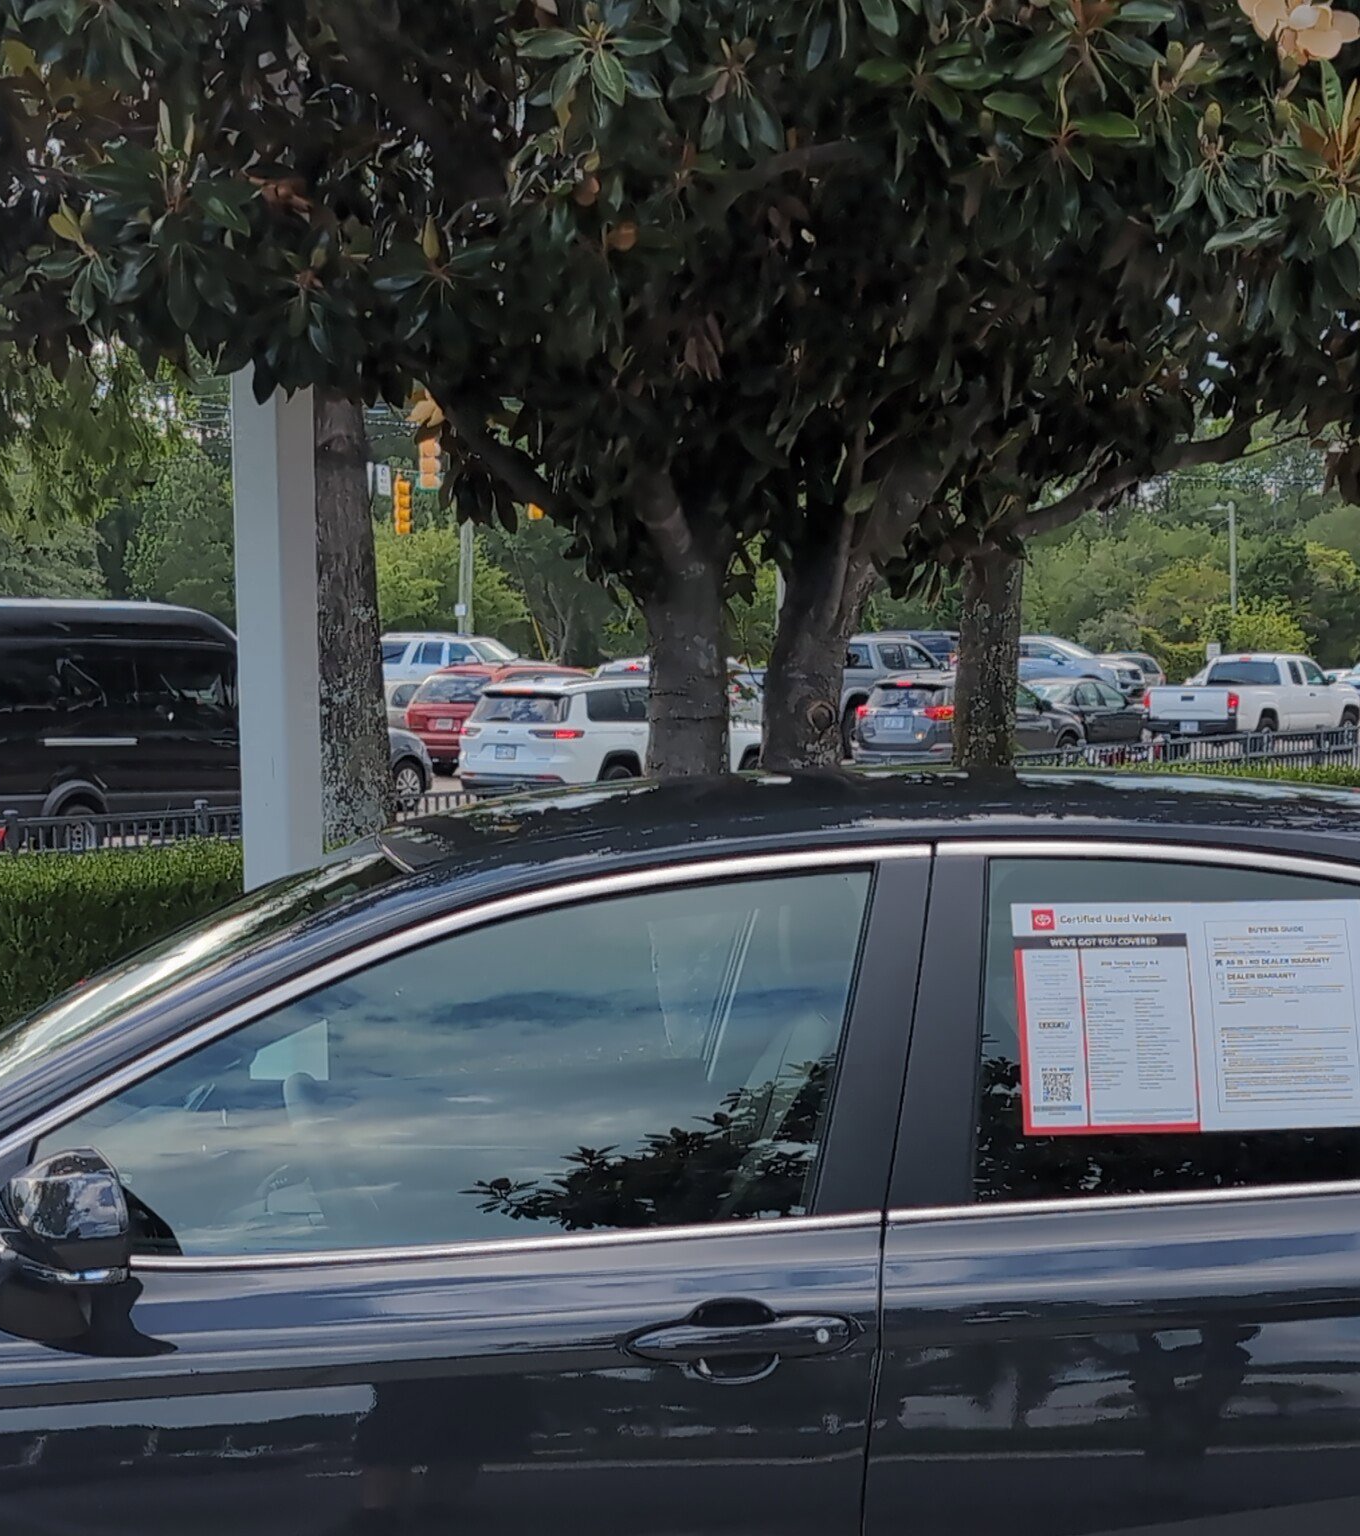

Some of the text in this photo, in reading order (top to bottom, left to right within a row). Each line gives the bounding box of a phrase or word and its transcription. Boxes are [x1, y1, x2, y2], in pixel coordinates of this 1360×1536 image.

[1060, 913, 1172, 923] Certified Used Vehicles
[1078, 938, 1096, 946] GOT
[1098, 937, 1117, 946] YOU
[1118, 936, 1158, 946] COVERED
[1257, 972, 1296, 980] WARRANTY
